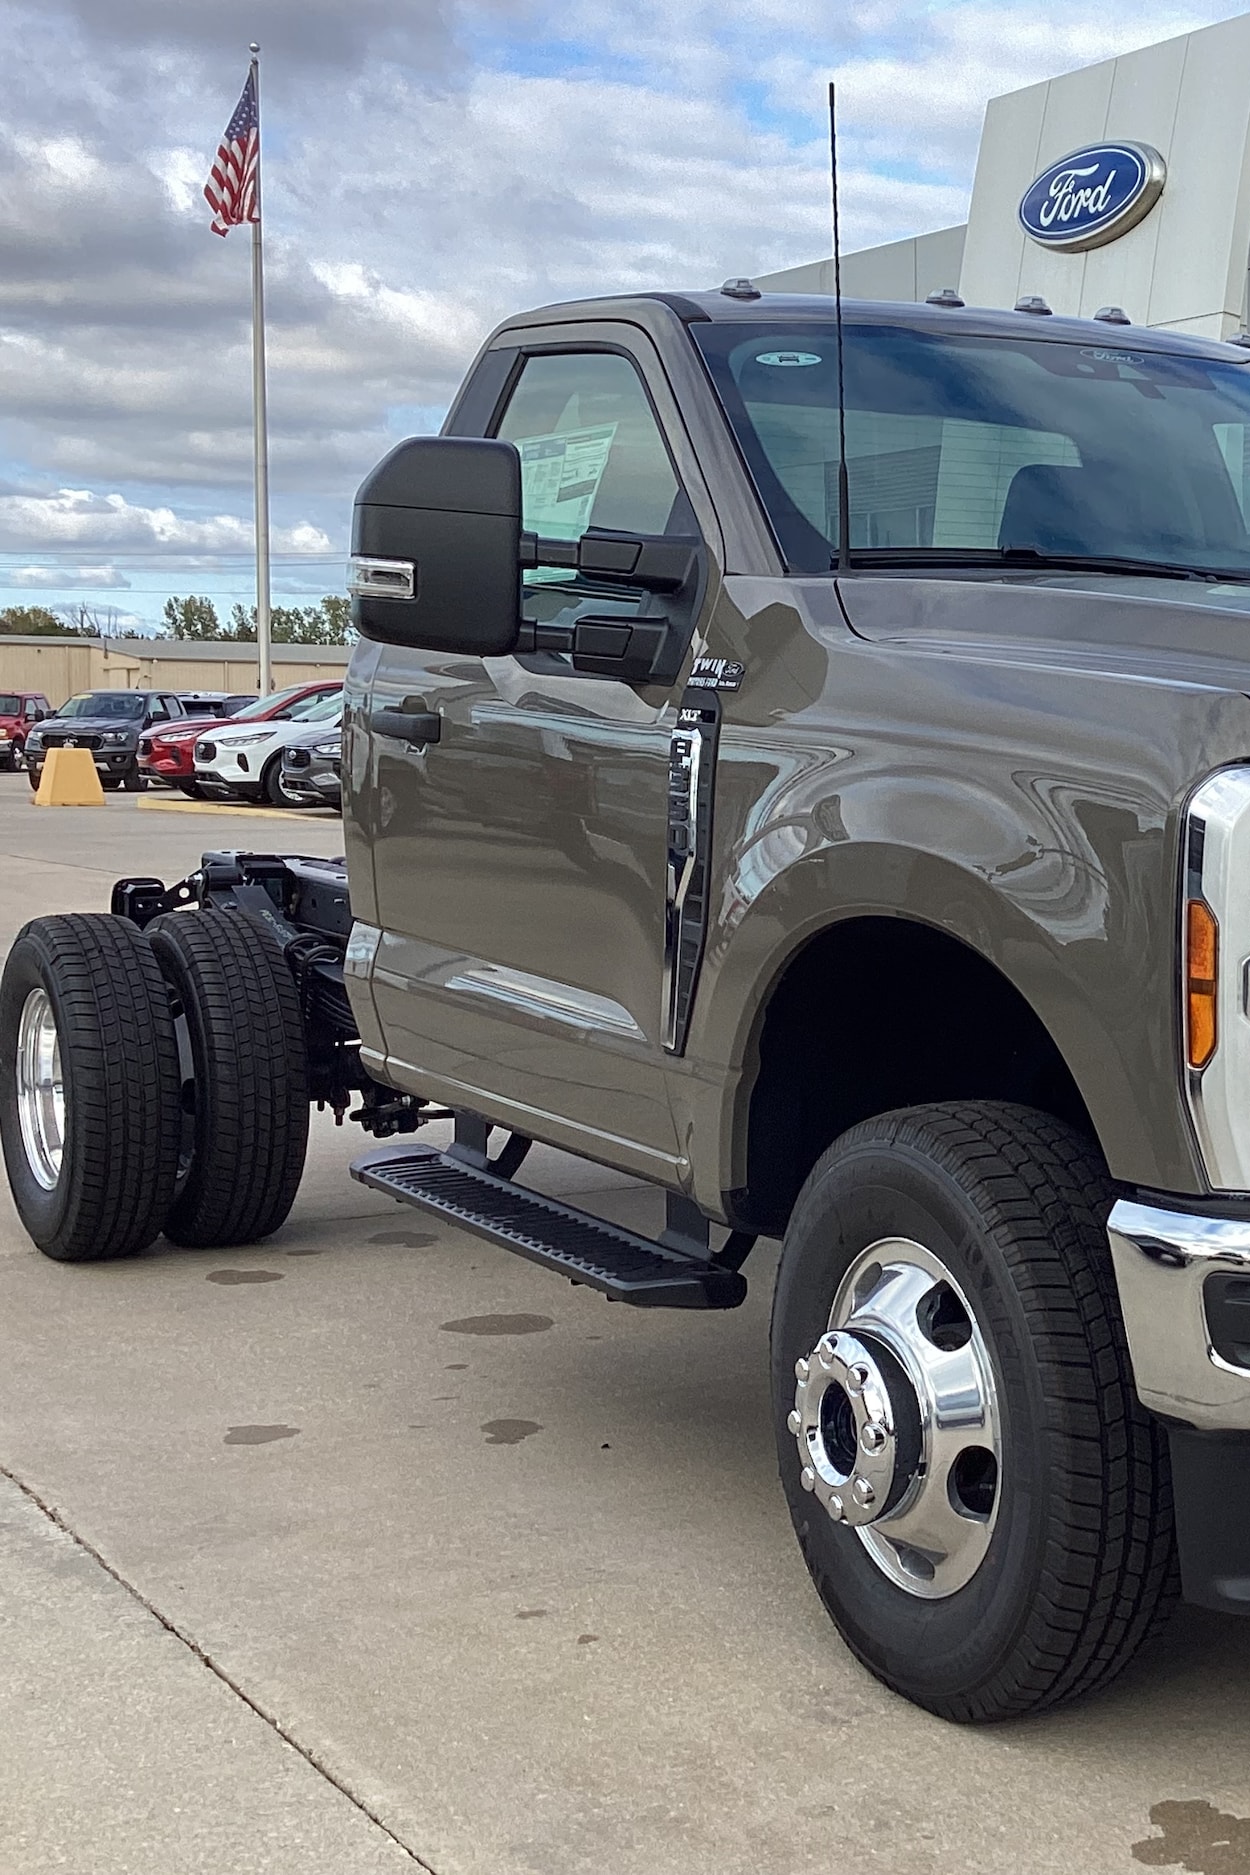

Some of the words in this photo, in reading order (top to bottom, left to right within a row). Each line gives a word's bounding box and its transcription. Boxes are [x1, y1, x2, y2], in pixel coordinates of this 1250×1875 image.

[1040, 163, 1117, 228] Ford
[691, 657, 727, 679] TWIN
[680, 708, 701, 721] XLT
